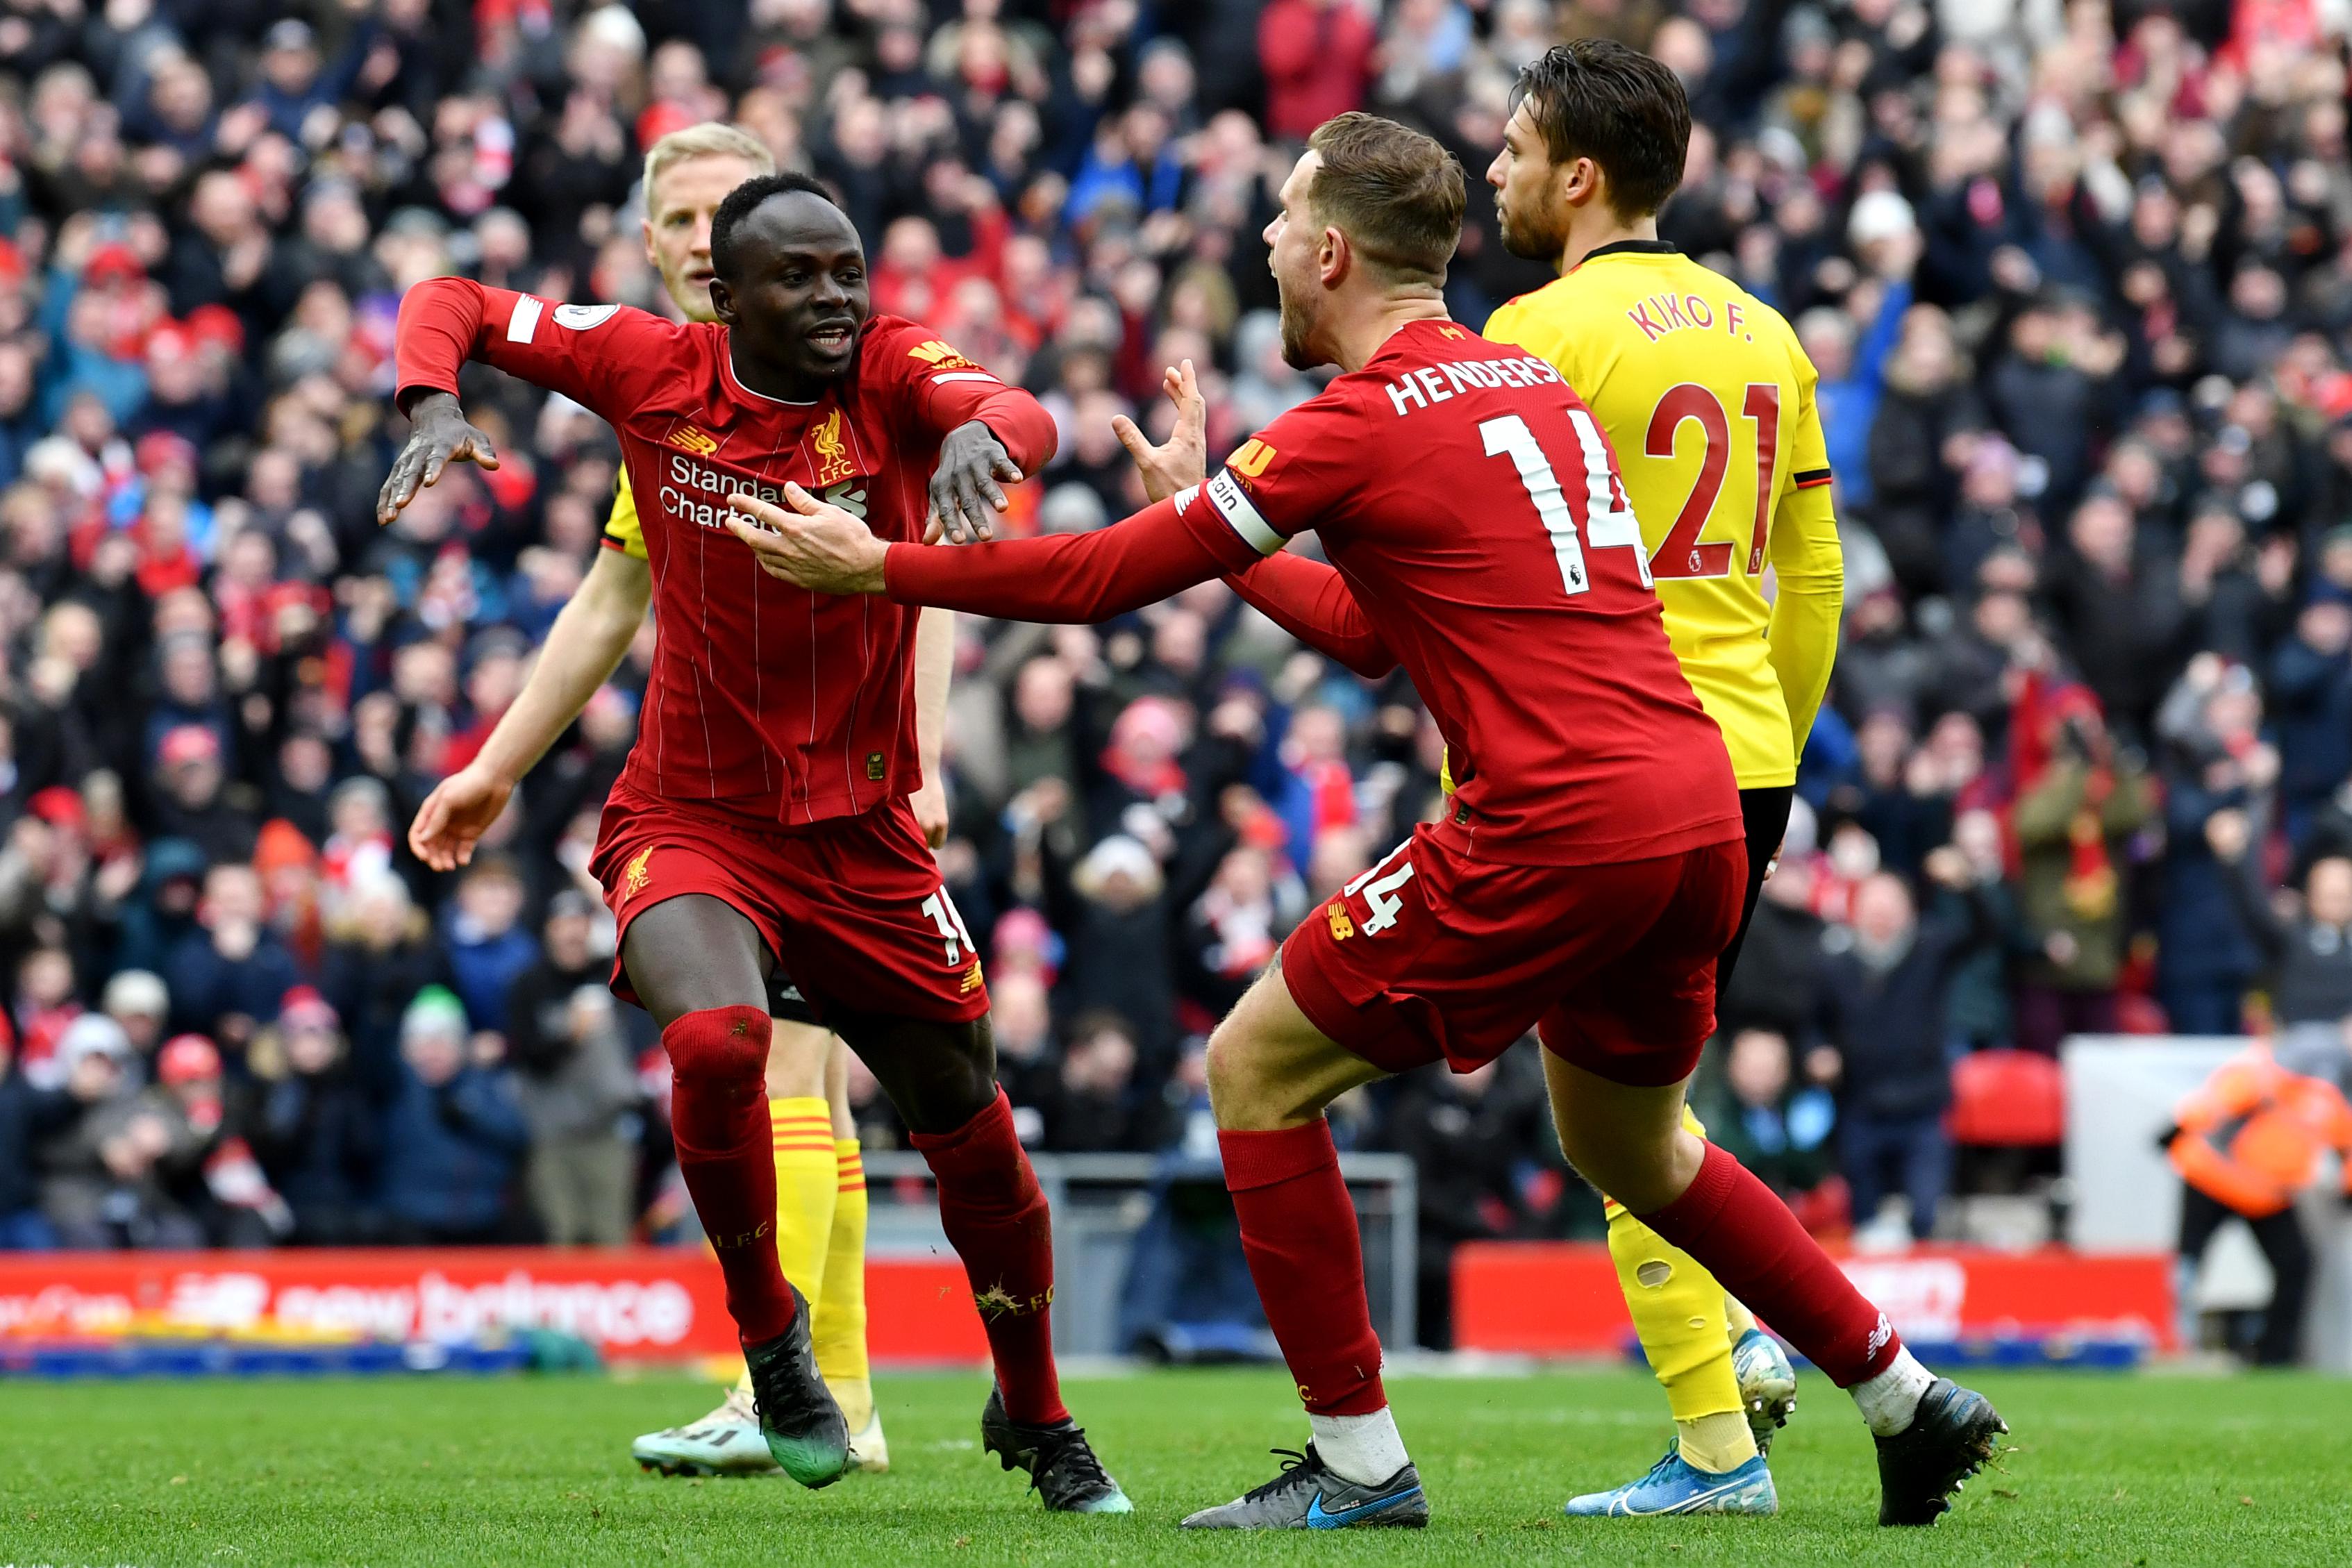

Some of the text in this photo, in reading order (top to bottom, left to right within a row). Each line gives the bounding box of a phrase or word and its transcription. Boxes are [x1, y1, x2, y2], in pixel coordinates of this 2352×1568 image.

[1628, 293, 1753, 342] KIKO F.
[670, 455, 812, 504] Standar
[819, 460, 857, 486] L.F.C.
[1644, 382, 1779, 581] 21
[1478, 409, 1654, 596] 14
